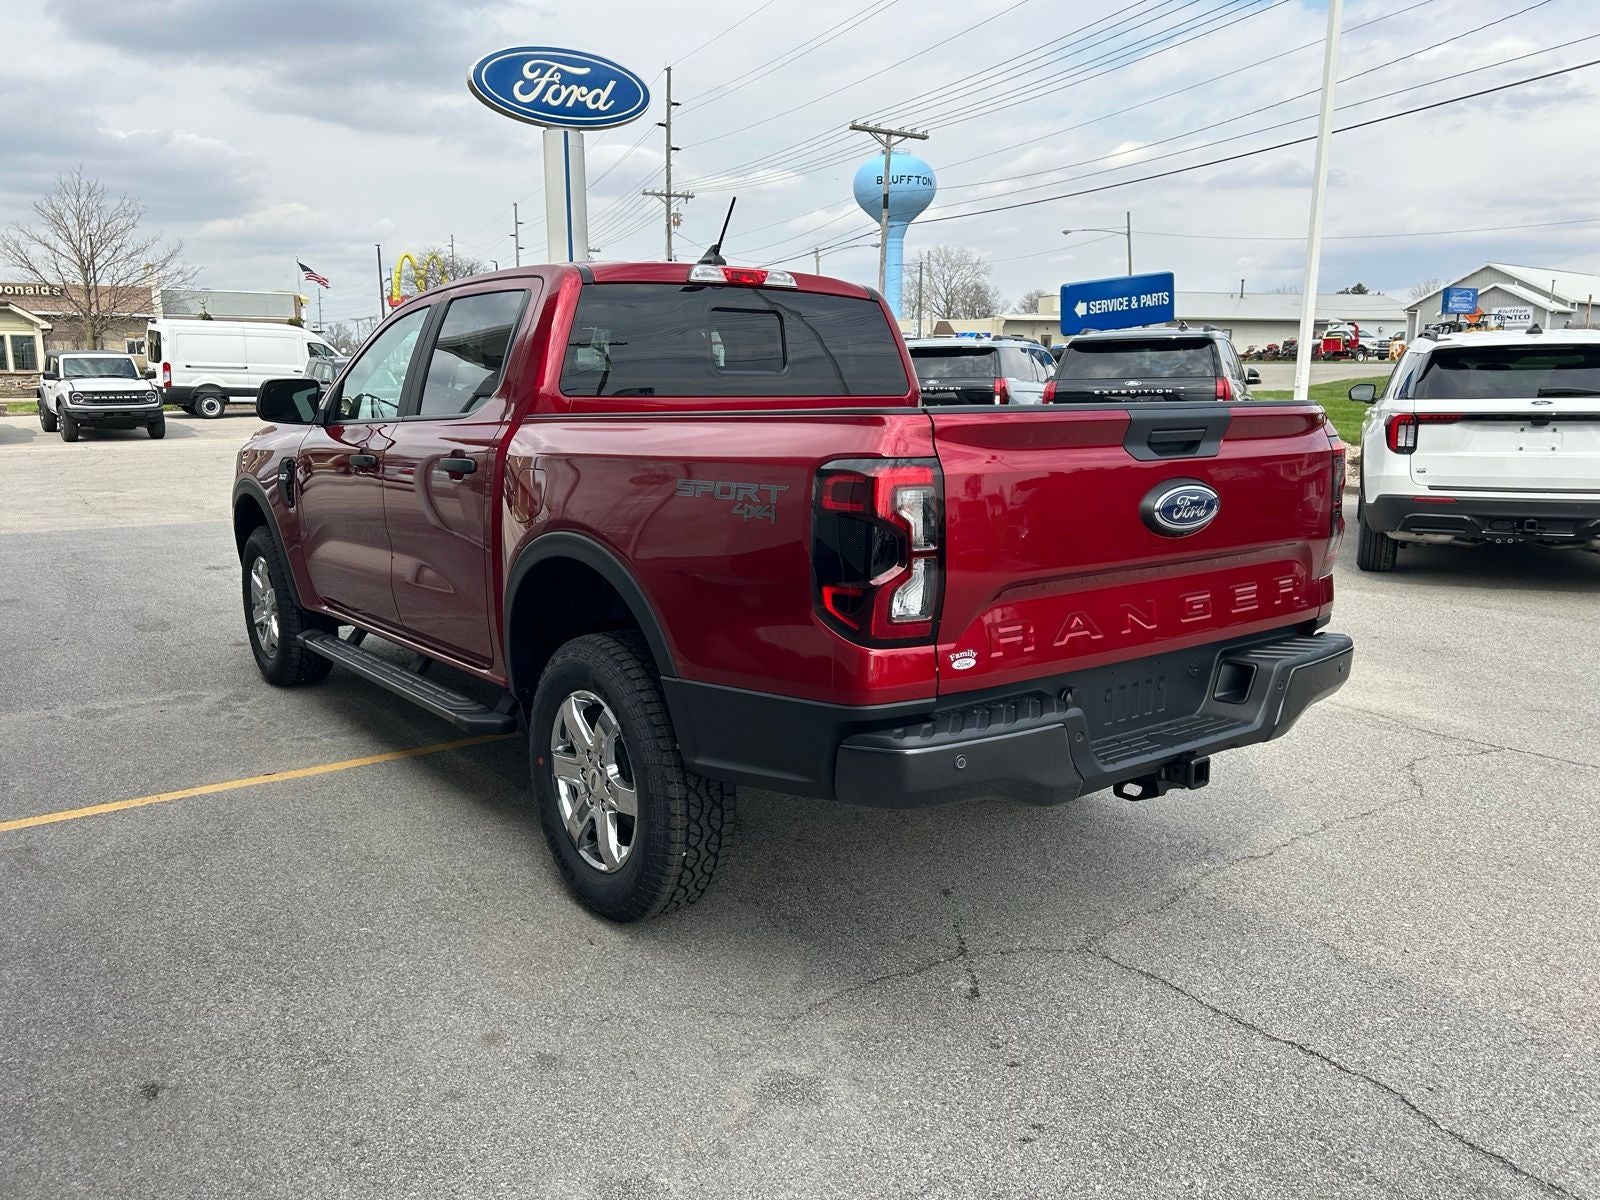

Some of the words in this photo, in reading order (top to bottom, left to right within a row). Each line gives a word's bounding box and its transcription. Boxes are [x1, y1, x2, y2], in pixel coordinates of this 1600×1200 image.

[512, 59, 617, 112] Ford
[876, 175, 933, 186] BUFFTON
[1089, 297, 1129, 315] SERVICE
[1131, 296, 1139, 309] &
[1140, 292, 1170, 308] PARTS
[675, 479, 789, 504] SPORT
[1173, 495, 1208, 520] Ford
[990, 575, 1309, 658] RANGER
[949, 649, 978, 662] Family
